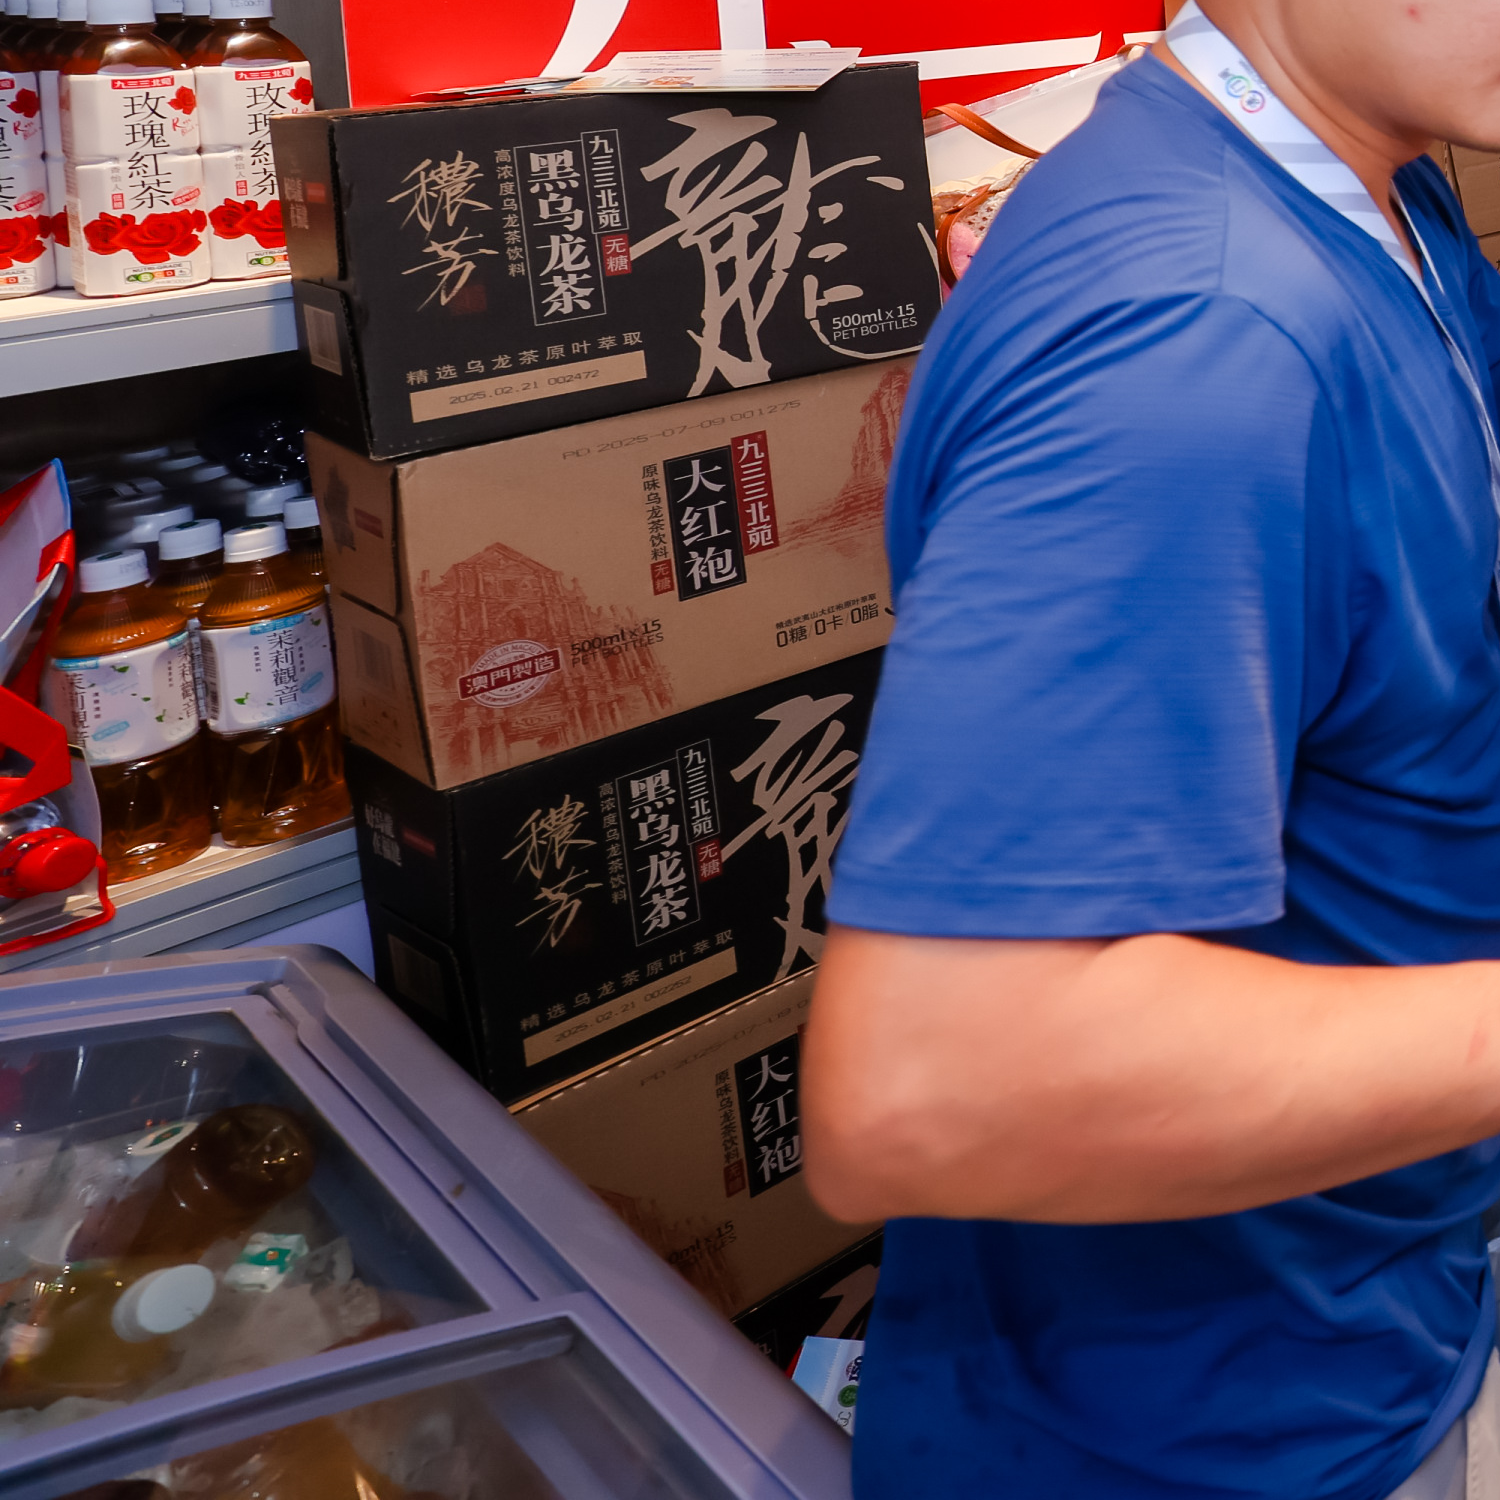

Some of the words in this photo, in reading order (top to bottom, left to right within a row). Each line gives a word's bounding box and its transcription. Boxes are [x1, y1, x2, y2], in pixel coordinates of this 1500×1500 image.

[114, 78, 173, 89] 九三三北苑
[236, 69, 293, 80] 九三三北苑
[122, 90, 176, 211] 玫瑰紅茶
[587, 135, 623, 228] 九三三北苑
[493, 149, 527, 278] 高浓度乌龙茶饮料
[526, 148, 596, 319] 黑乌龙茶
[131, 263, 183, 274] NUTRI-GRADE
[603, 237, 630, 274] 无糖
[832, 308, 883, 330] 500ml
[896, 303, 916, 318] 15
[833, 327, 859, 341] PET
[860, 316, 918, 337] BOTTLES
[405, 330, 644, 387] 精选乌龙茶原叶萃取
[449, 380, 540, 405] 2025.02.21
[546, 369, 600, 388] 002472
[597, 416, 726, 454] 2025-07-09
[730, 399, 801, 421] 001275
[641, 463, 670, 561] 原味乌龙茶饮料
[736, 438, 775, 550] 九三三北苑
[673, 458, 738, 591] 大红袍
[654, 562, 673, 593] 无糖
[570, 629, 627, 657] 500ml
[641, 618, 662, 635] 15
[571, 651, 597, 669] PET
[599, 632, 664, 663] BOTTLES
[265, 629, 300, 706] 茉莉觀音
[466, 655, 555, 694] 澳門製造
[683, 748, 715, 837] 九三三北苑
[597, 781, 628, 905] 高浓度乌龙茶饮料
[627, 769, 691, 937] 黑乌龙茶
[698, 842, 722, 879] 无糖
[520, 928, 733, 1033] 精选乌龙茶原叶萃取
[744, 1054, 804, 1184] 大红袍
